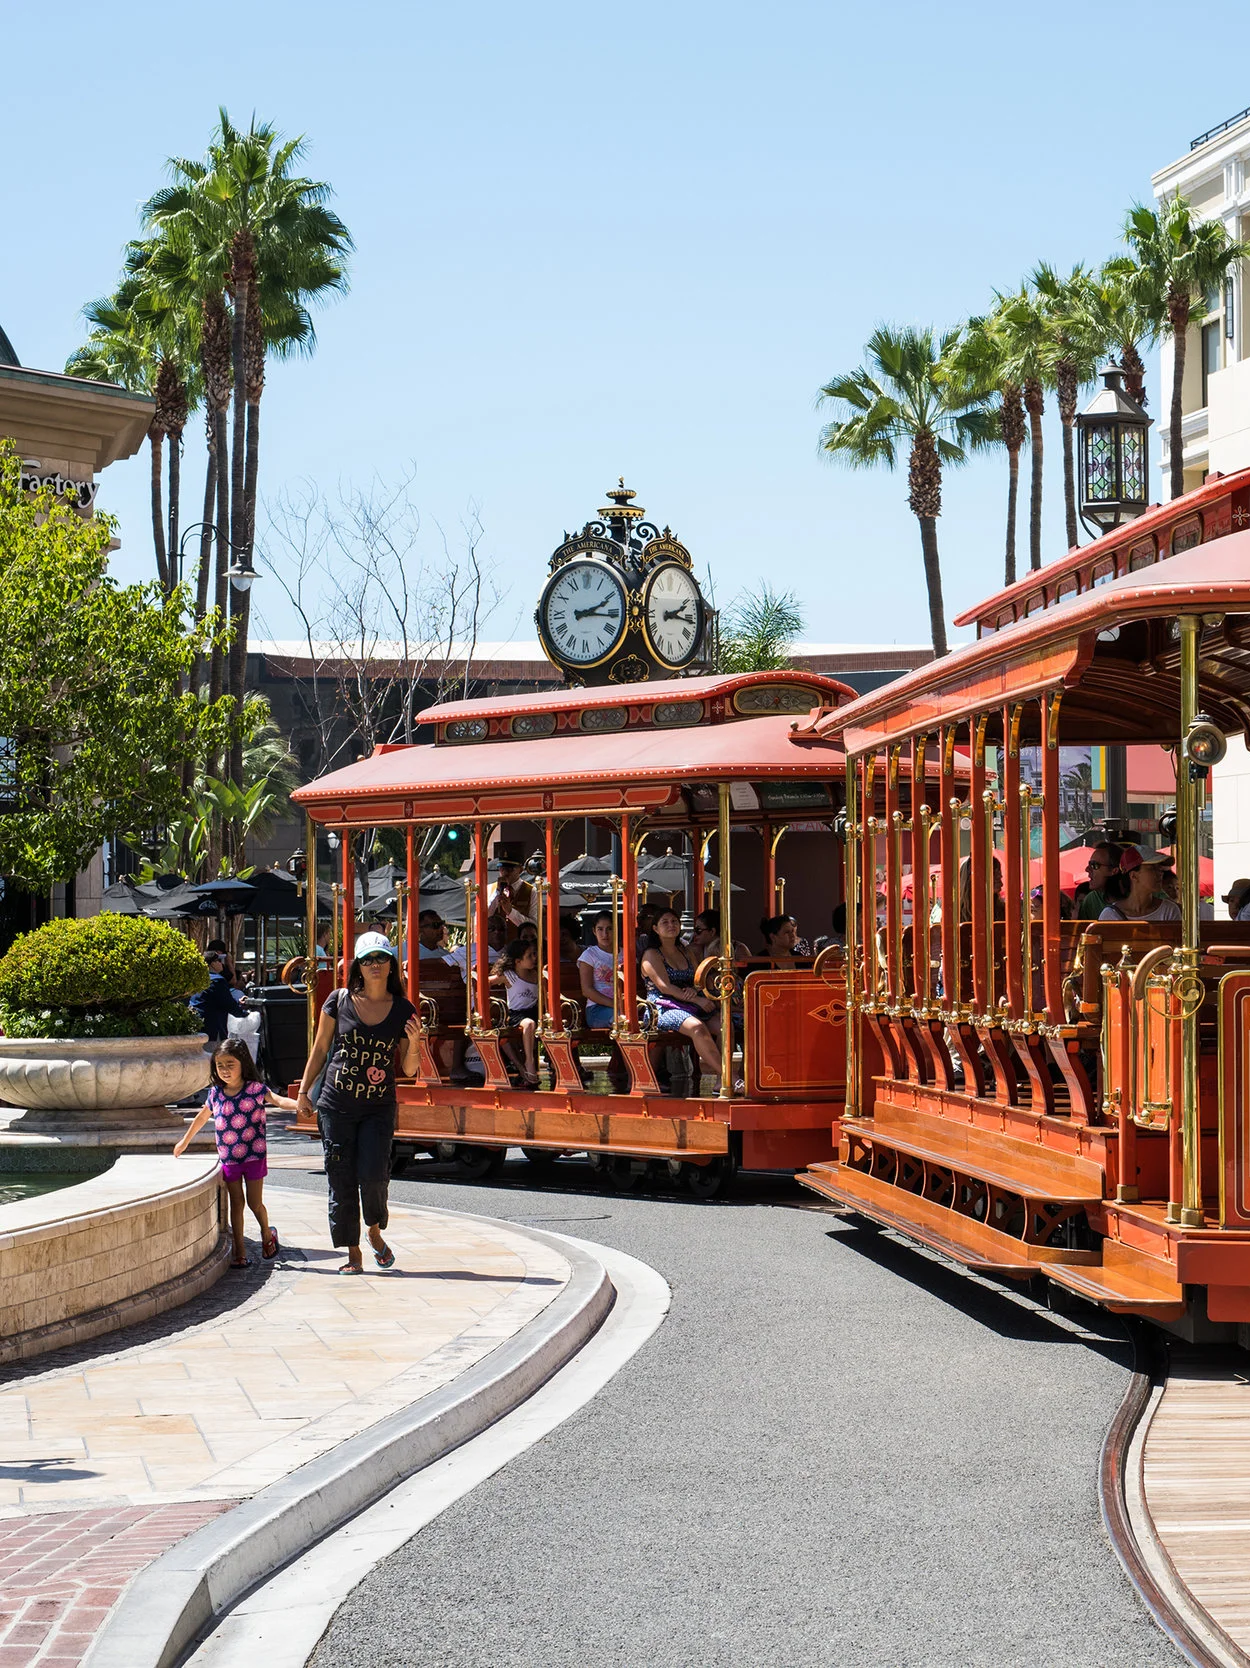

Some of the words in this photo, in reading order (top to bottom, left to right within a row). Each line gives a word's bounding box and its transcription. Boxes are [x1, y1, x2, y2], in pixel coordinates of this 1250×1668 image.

[562, 545, 576, 556] THE
[576, 541, 613, 554] AMERICANA
[341, 1062, 359, 1076] be
[334, 1069, 387, 1099] happy
